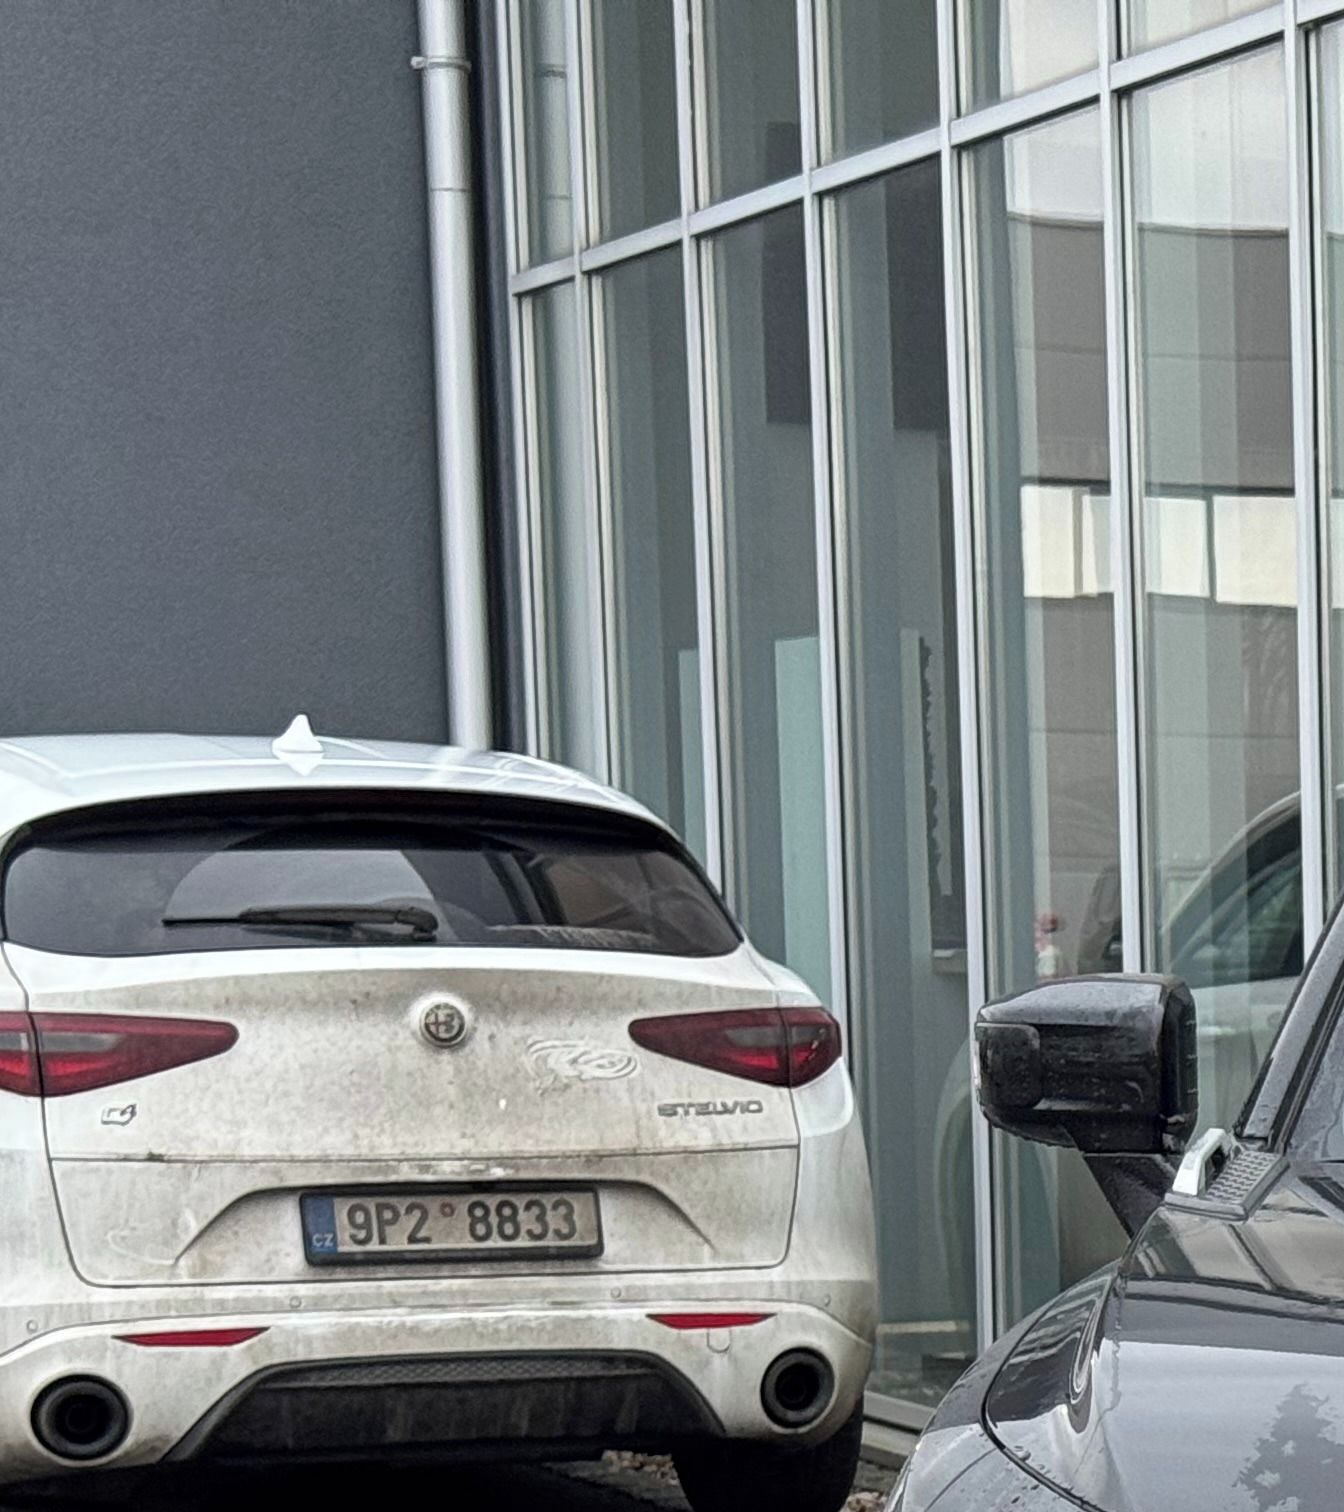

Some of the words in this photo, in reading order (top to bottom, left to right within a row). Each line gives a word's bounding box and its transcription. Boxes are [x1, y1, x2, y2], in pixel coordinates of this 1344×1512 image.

[657, 1100, 763, 1117] STELVIO
[346, 1202, 432, 1246] 9P2
[467, 1198, 577, 1242] 8833
[312, 1233, 334, 1248] CZ
